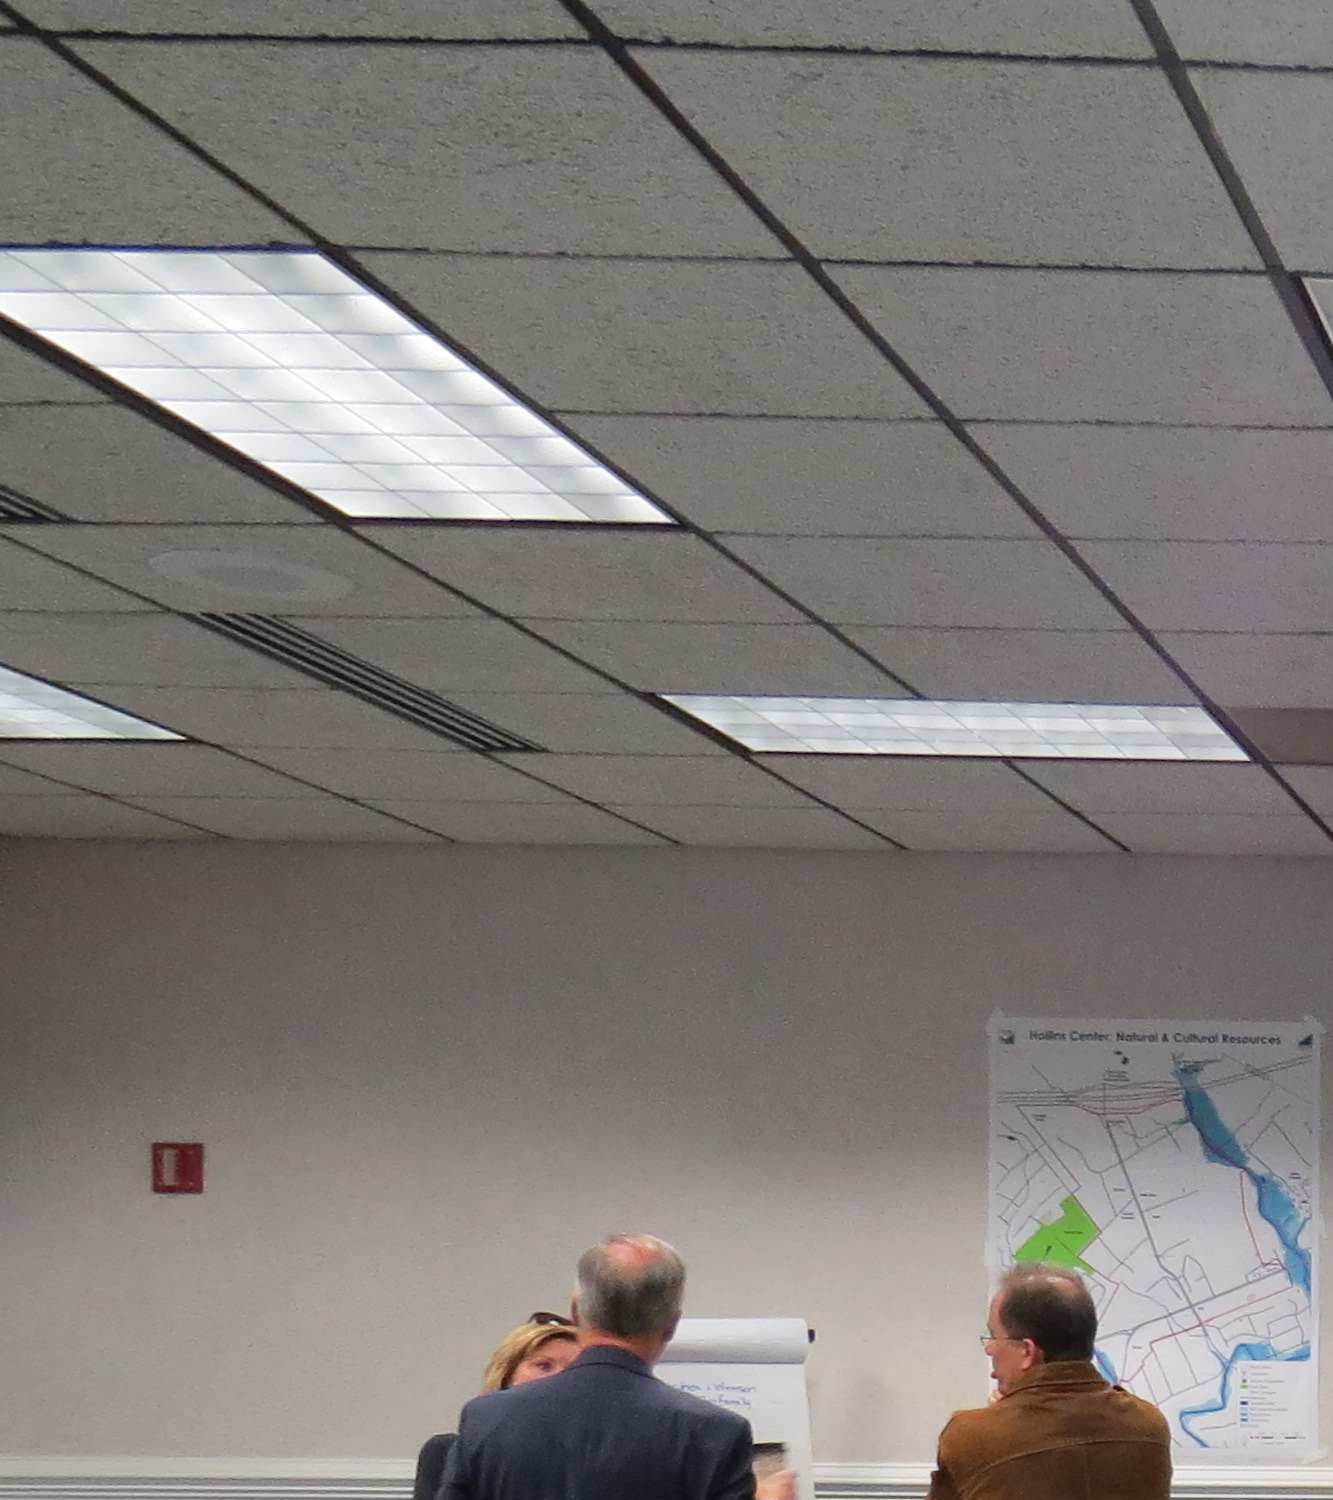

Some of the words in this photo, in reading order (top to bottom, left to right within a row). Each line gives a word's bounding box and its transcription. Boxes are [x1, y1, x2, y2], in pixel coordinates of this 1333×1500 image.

[1029, 1029, 1067, 1043] Hollins
[1115, 1031, 1160, 1044] Natural
[1162, 1033, 1170, 1044] &
[1173, 1032, 1219, 1045] Cultural
[1221, 1033, 1283, 1047] Resources
